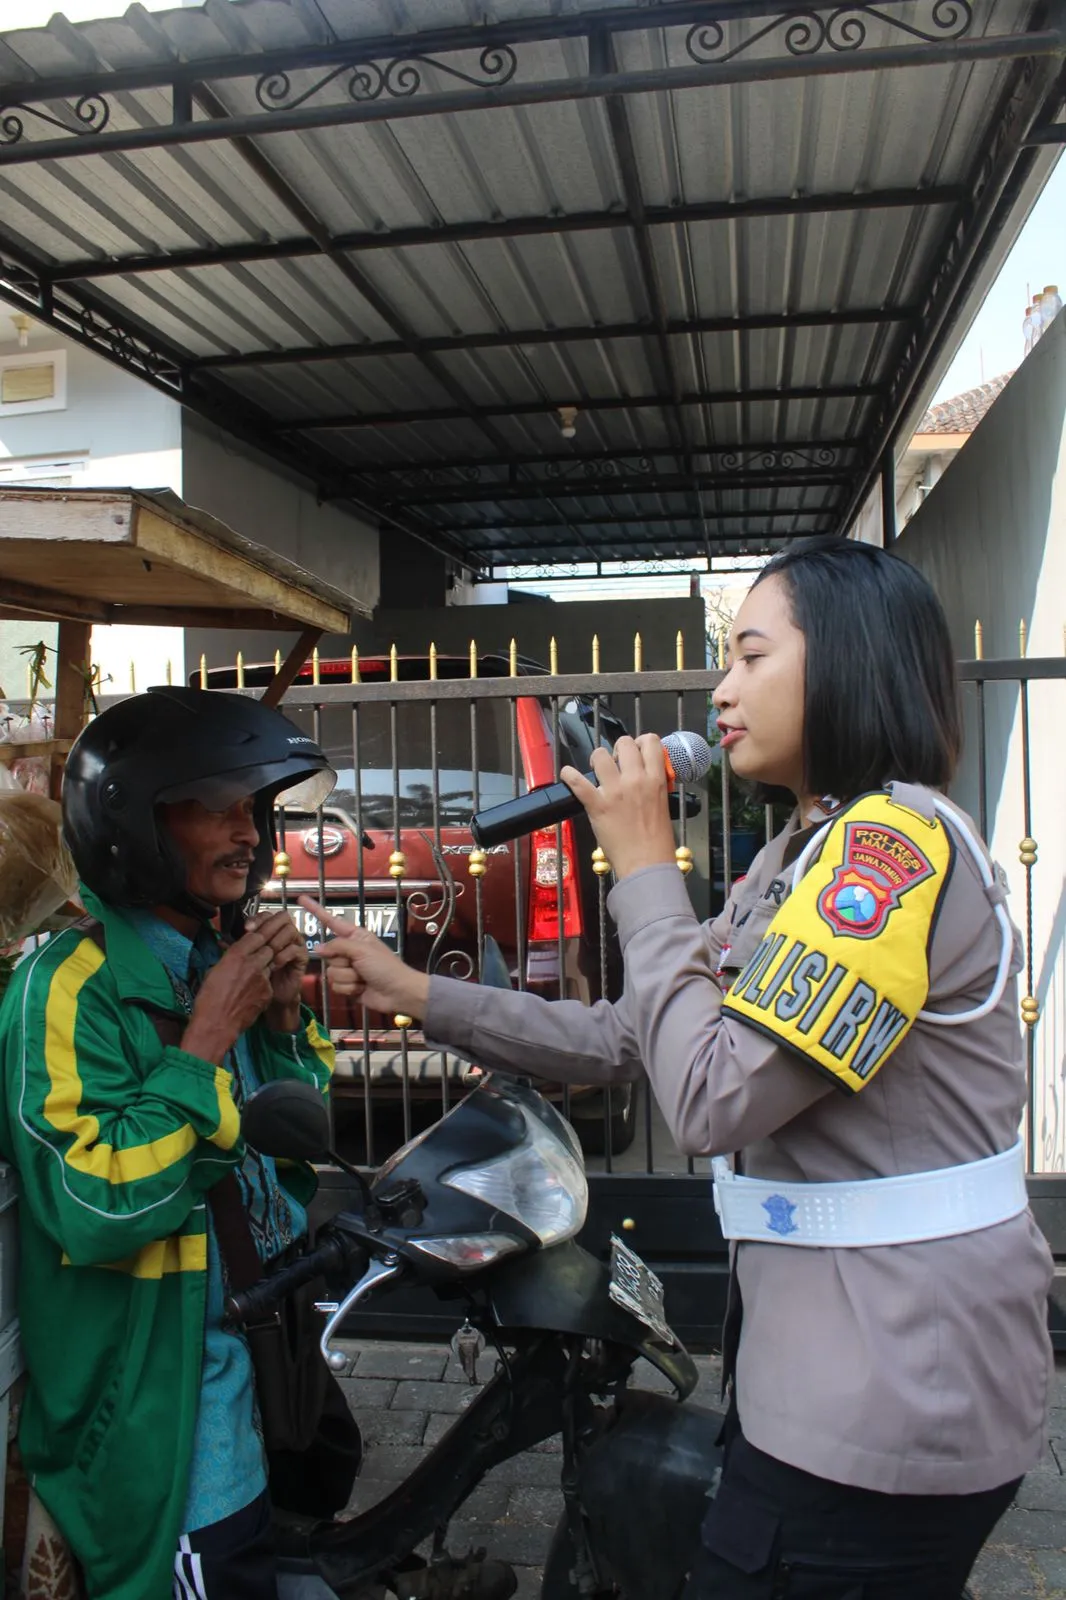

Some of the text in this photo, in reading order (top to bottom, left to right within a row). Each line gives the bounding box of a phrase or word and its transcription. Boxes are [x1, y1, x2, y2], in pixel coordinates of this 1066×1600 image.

[441, 844, 509, 854] XEIA
[856, 830, 921, 870] POLRES
[861, 838, 911, 869] MALANG
[853, 852, 903, 885] JAWA TIMUR
[819, 977, 909, 1081] RW
